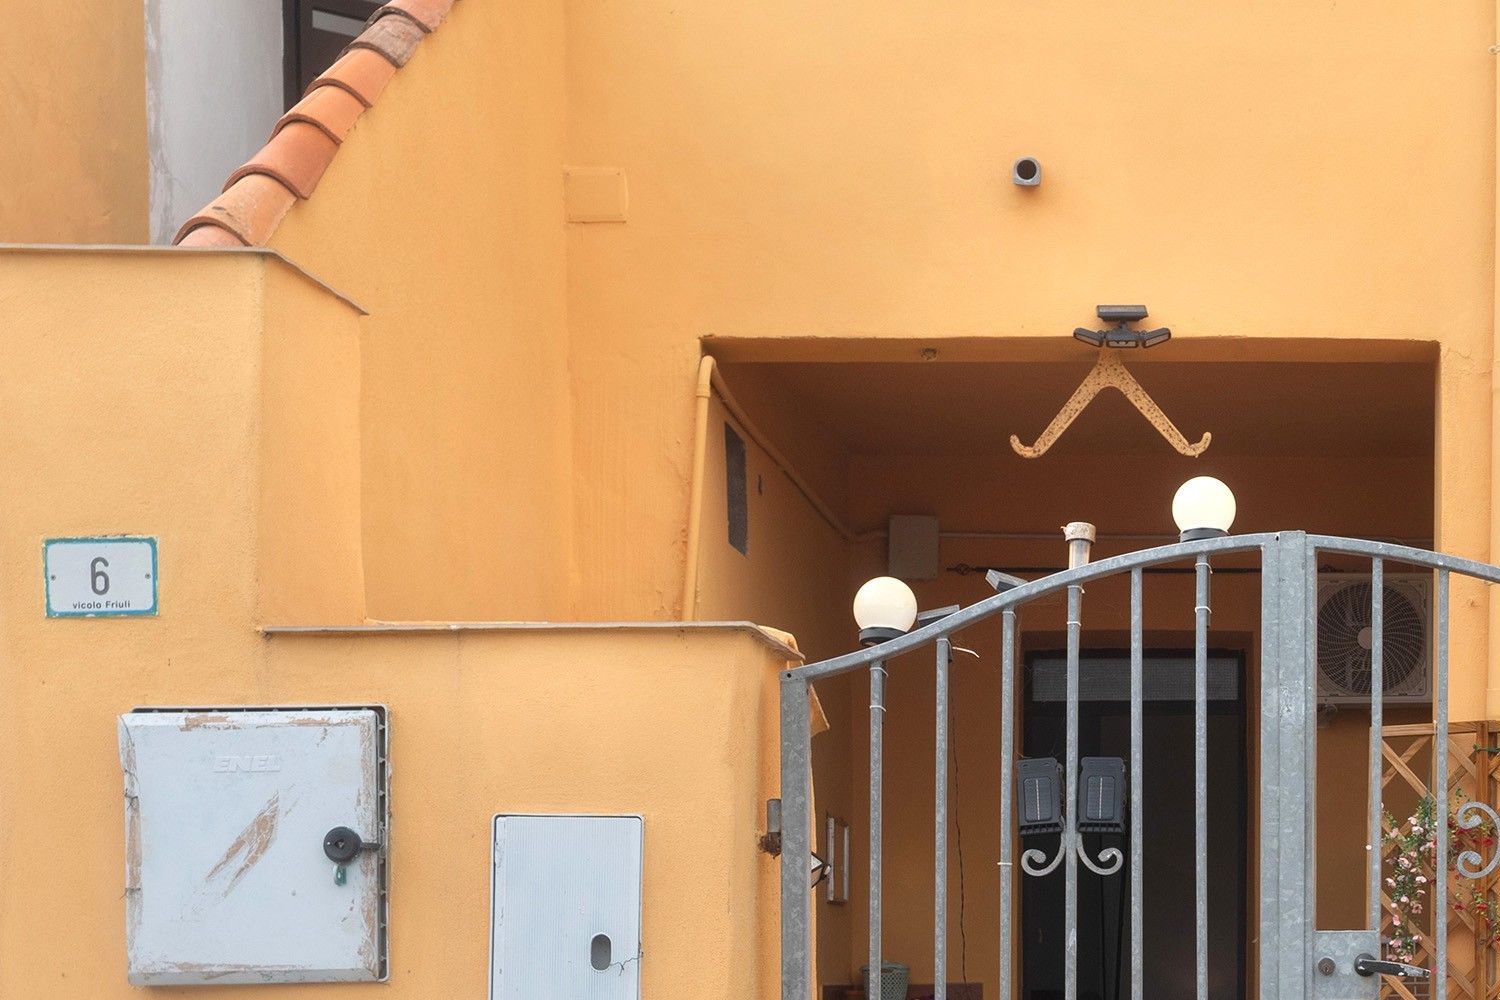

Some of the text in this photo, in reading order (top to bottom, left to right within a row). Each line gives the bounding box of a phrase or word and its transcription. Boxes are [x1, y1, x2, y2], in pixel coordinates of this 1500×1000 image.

[91, 557, 109, 596] 6
[72, 600, 131, 610] vicolo Friuli
